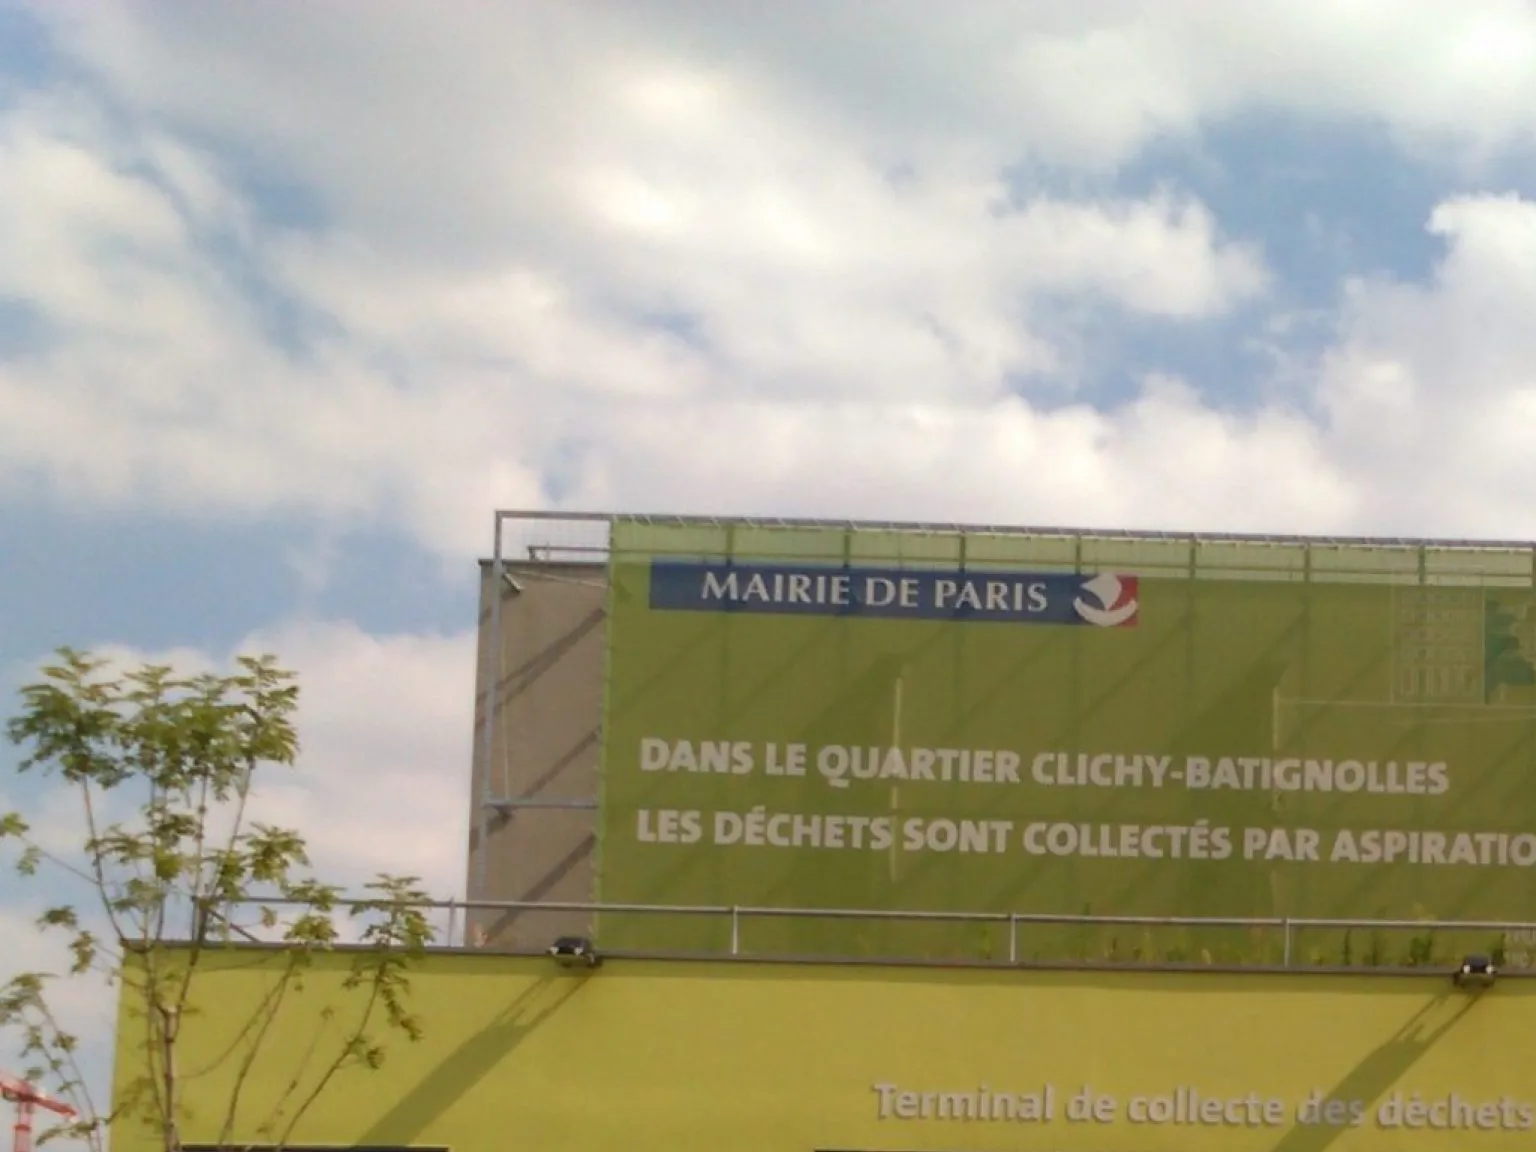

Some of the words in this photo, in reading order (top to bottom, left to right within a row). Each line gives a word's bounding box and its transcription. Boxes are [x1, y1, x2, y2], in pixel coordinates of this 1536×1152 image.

[701, 571, 850, 606] MAIRIE
[865, 576, 919, 608] DE
[934, 578, 1048, 613] PARIS
[639, 737, 754, 775] DANS
[765, 742, 807, 776] LE
[816, 744, 1020, 788] QUARTIER
[1031, 752, 1450, 795] CLICHY-BATIGNOLLES
[636, 808, 702, 844] LES
[713, 804, 894, 851] DÉCHETS
[903, 817, 1013, 854] SONT
[1023, 818, 1232, 860] COLLECTÉS
[1243, 829, 1322, 863] PAR
[872, 1081, 1056, 1123] Terminal
[1066, 1084, 1117, 1124] de
[1127, 1085, 1286, 1127] collecte
[1296, 1088, 1365, 1129] des
[1378, 1090, 1534, 1132] déchets
